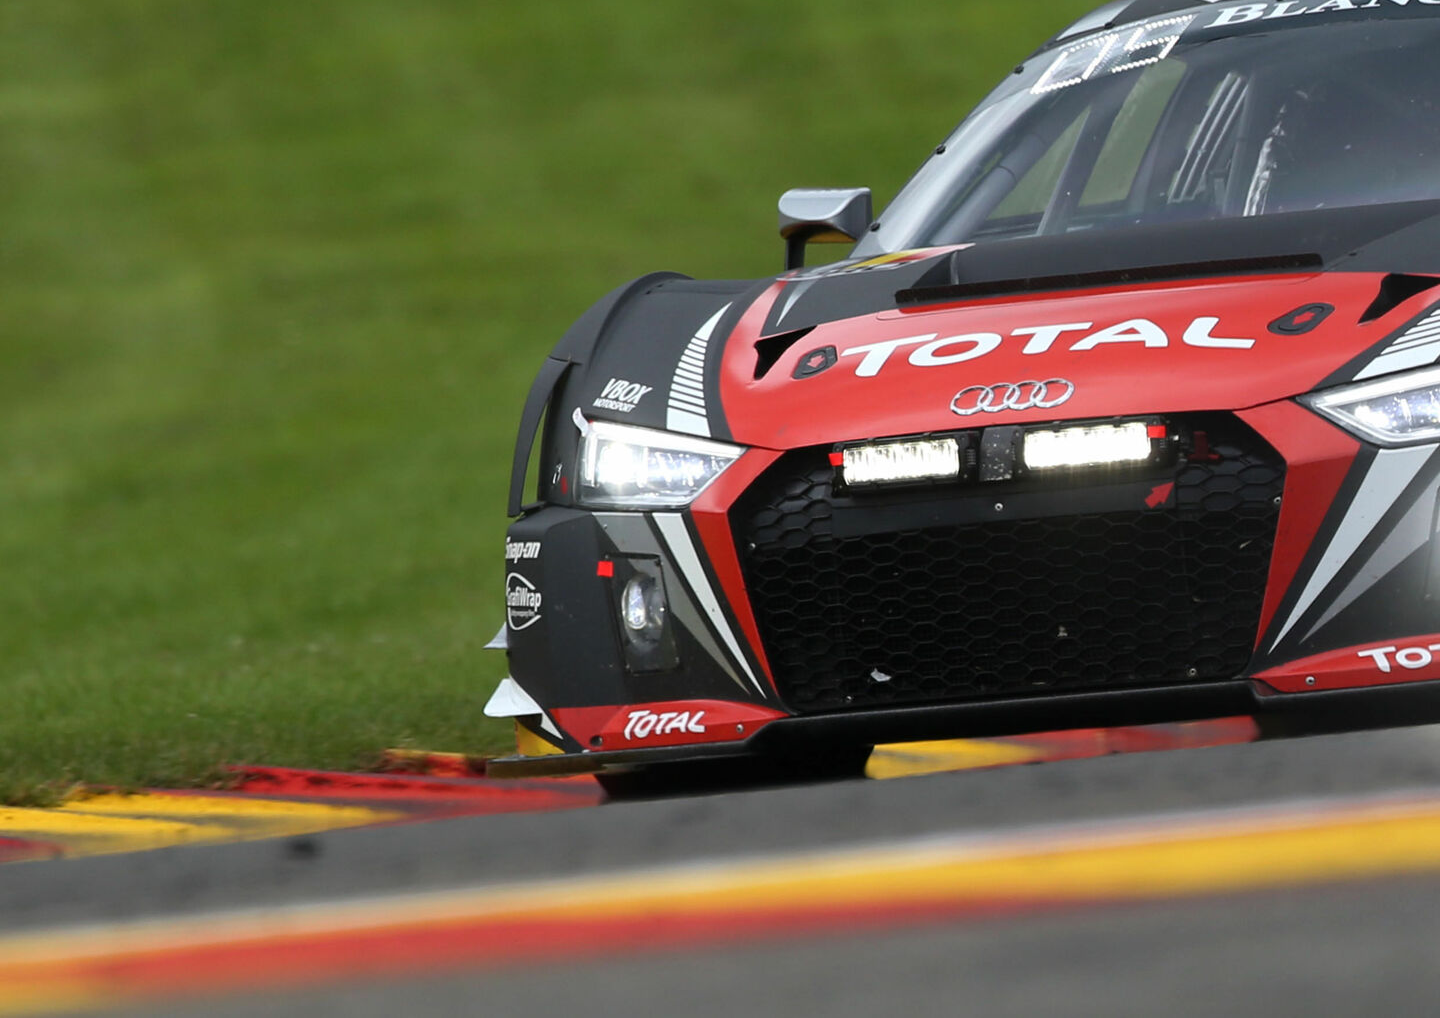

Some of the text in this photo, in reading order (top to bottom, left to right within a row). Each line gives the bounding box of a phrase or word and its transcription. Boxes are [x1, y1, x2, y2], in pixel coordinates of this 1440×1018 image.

[841, 316, 1257, 378] TOTAL
[600, 378, 653, 405] VBOX
[624, 710, 706, 741] TOTAL
